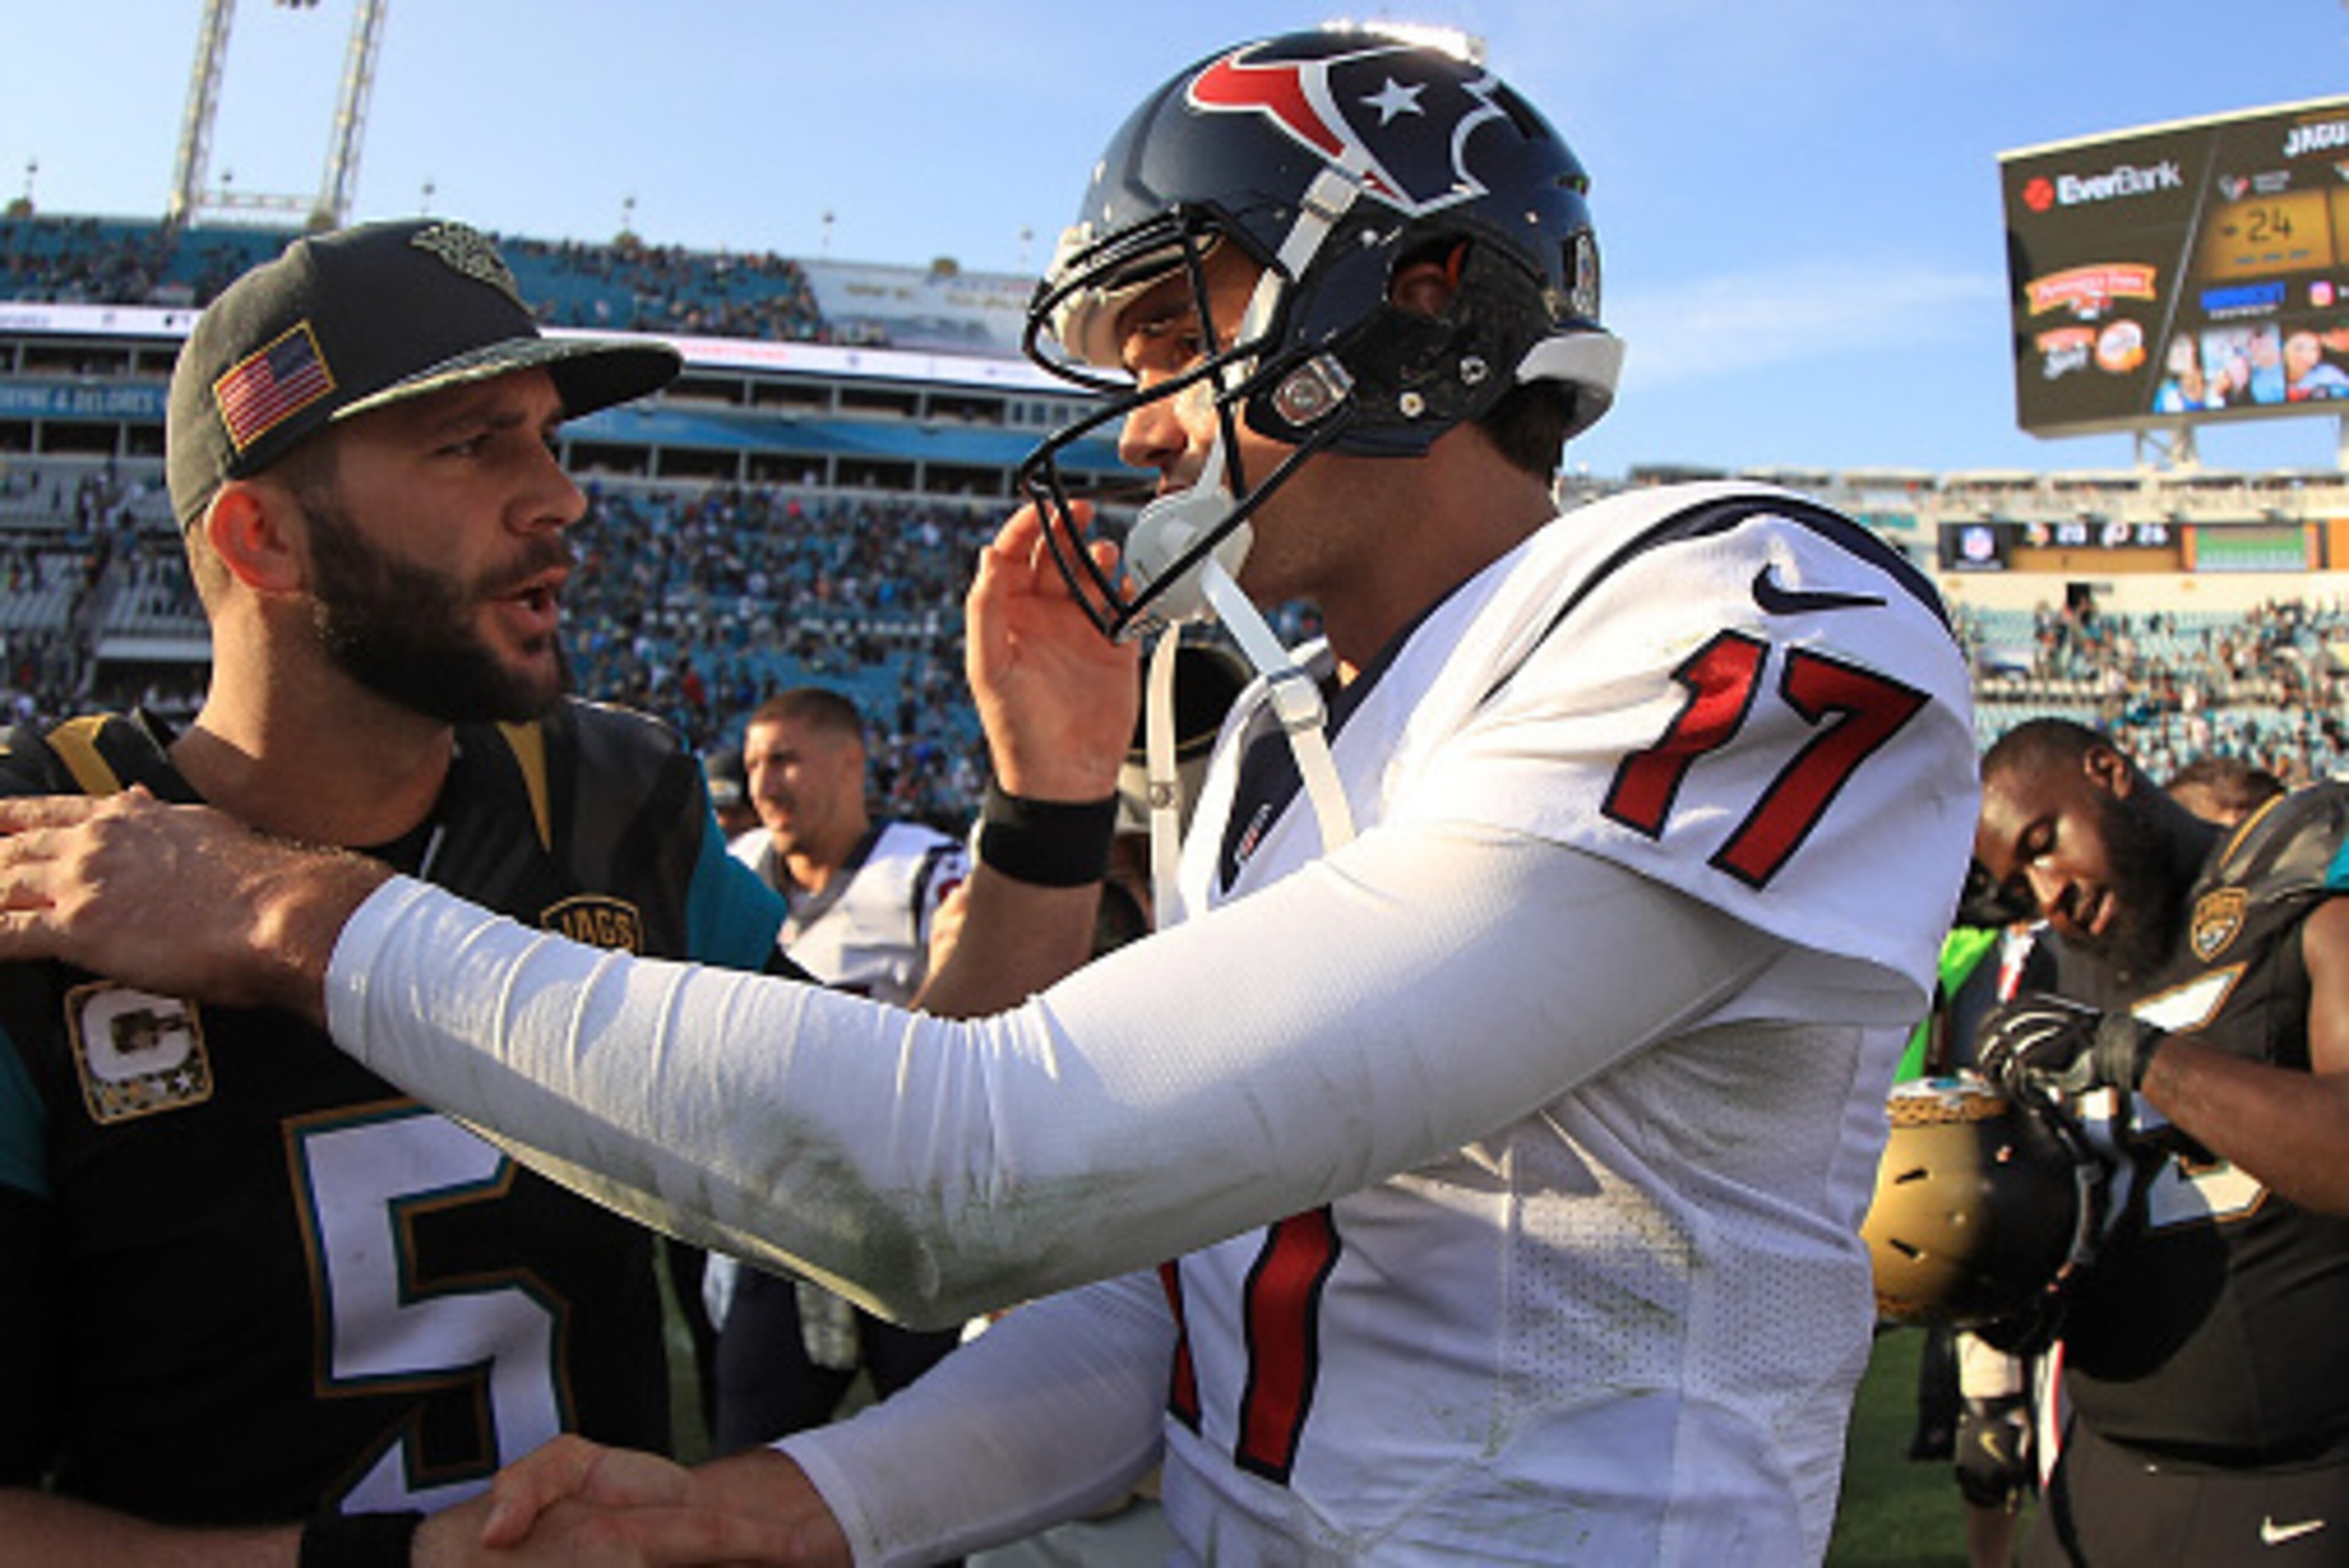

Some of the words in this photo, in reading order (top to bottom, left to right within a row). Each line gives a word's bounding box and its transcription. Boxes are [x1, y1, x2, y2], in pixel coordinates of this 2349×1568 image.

[2283, 121, 2349, 158] JAGU
[2056, 160, 2183, 205] EverBank
[2247, 207, 2291, 242] 24
[1600, 628, 1933, 893] 17
[281, 1099, 579, 1518] 5
